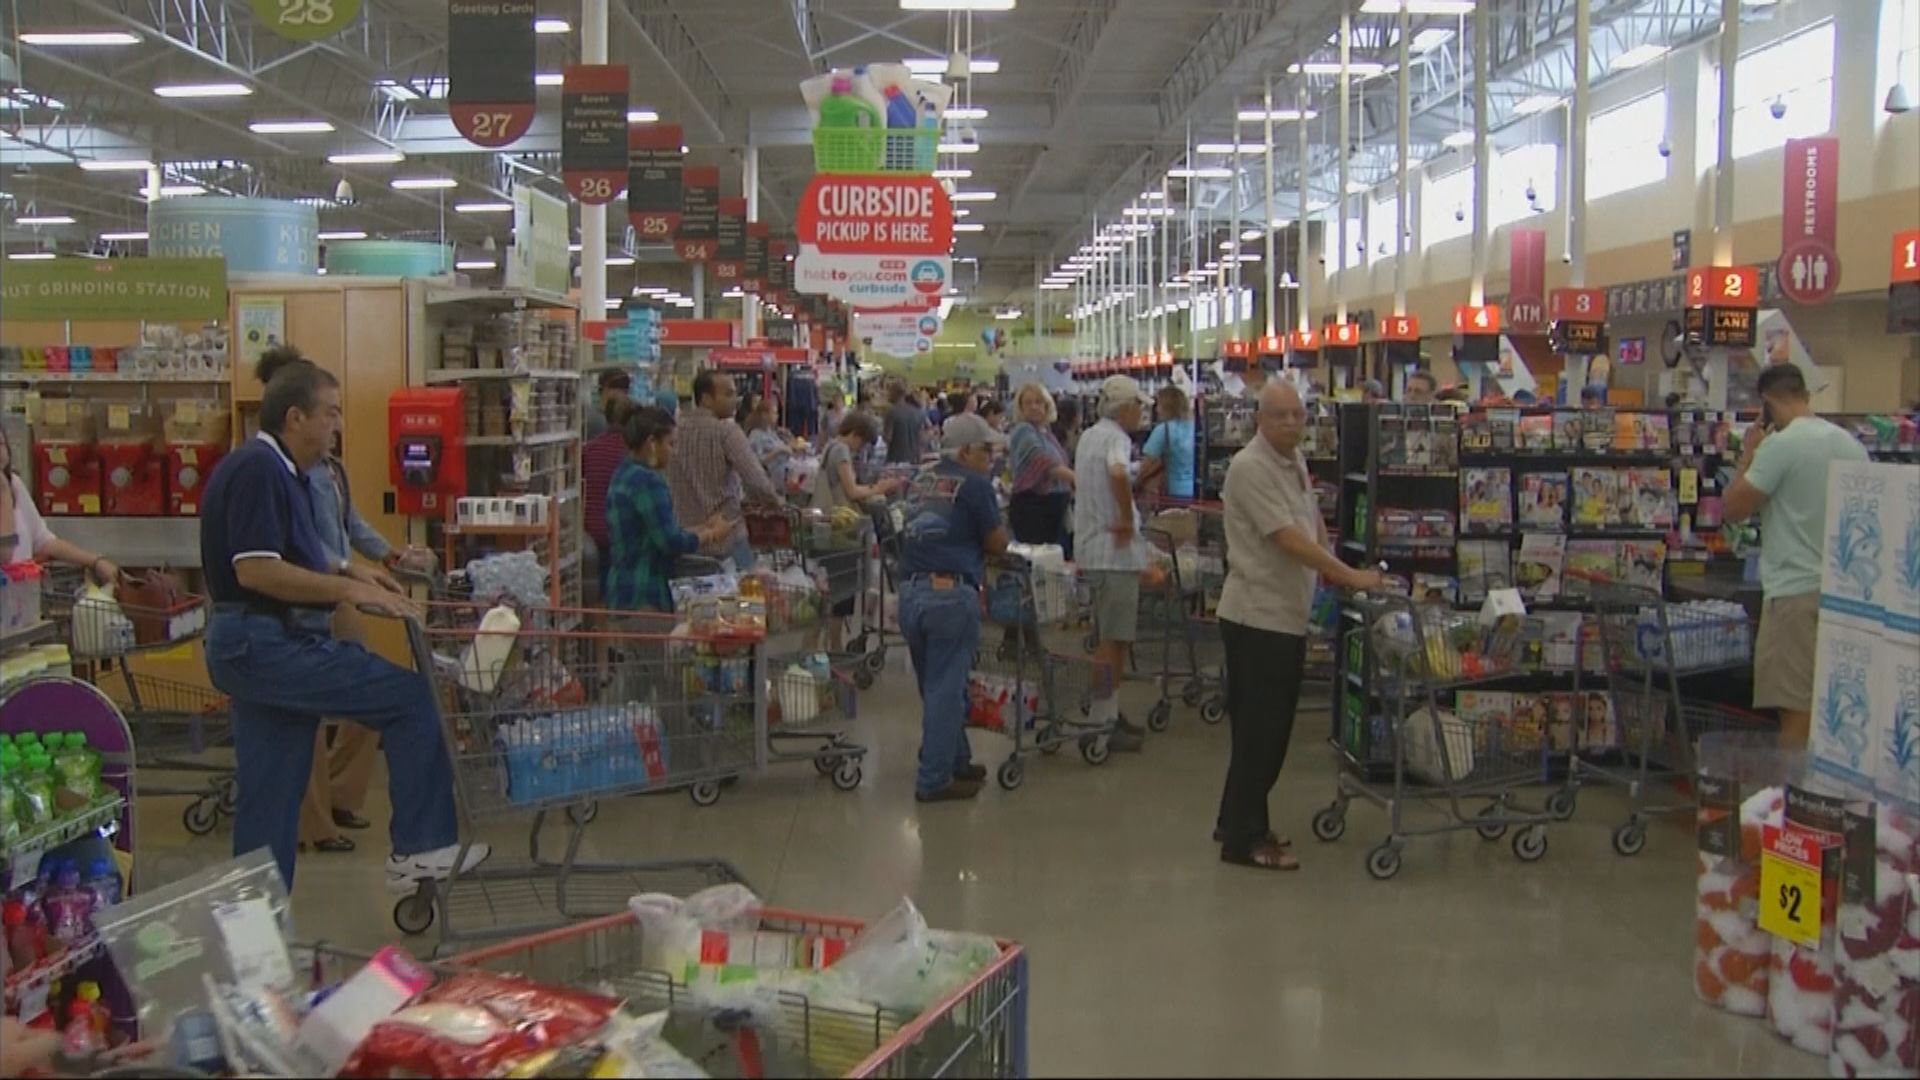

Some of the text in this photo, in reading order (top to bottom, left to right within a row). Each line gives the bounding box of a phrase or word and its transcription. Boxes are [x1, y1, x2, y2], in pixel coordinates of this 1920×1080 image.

[279, 0, 334, 24] 28
[451, 3, 534, 15] Greeting Cards
[471, 113, 512, 137] 27
[581, 178, 611, 197] 26
[1805, 147, 1817, 235] RESTROOMS
[818, 185, 933, 217] CURBSIDE
[644, 218, 668, 233] 25
[817, 221, 933, 243] PICKUP IS HERE.
[685, 244, 707, 259] 24
[1903, 240, 1917, 269] 1
[39, 280, 128, 296] GRINDING
[135, 281, 211, 300] STATION
[849, 283, 906, 293] curbside
[1723, 273, 1743, 297] 2
[1513, 304, 1541, 322] ATM
[1576, 294, 1590, 313] 3
[1397, 319, 1409, 336] 5
[1474, 309, 1489, 328] 4
[1714, 317, 1749, 329] LANE
[1779, 830, 1804, 848] LOW
[1779, 883, 1803, 923] $2
